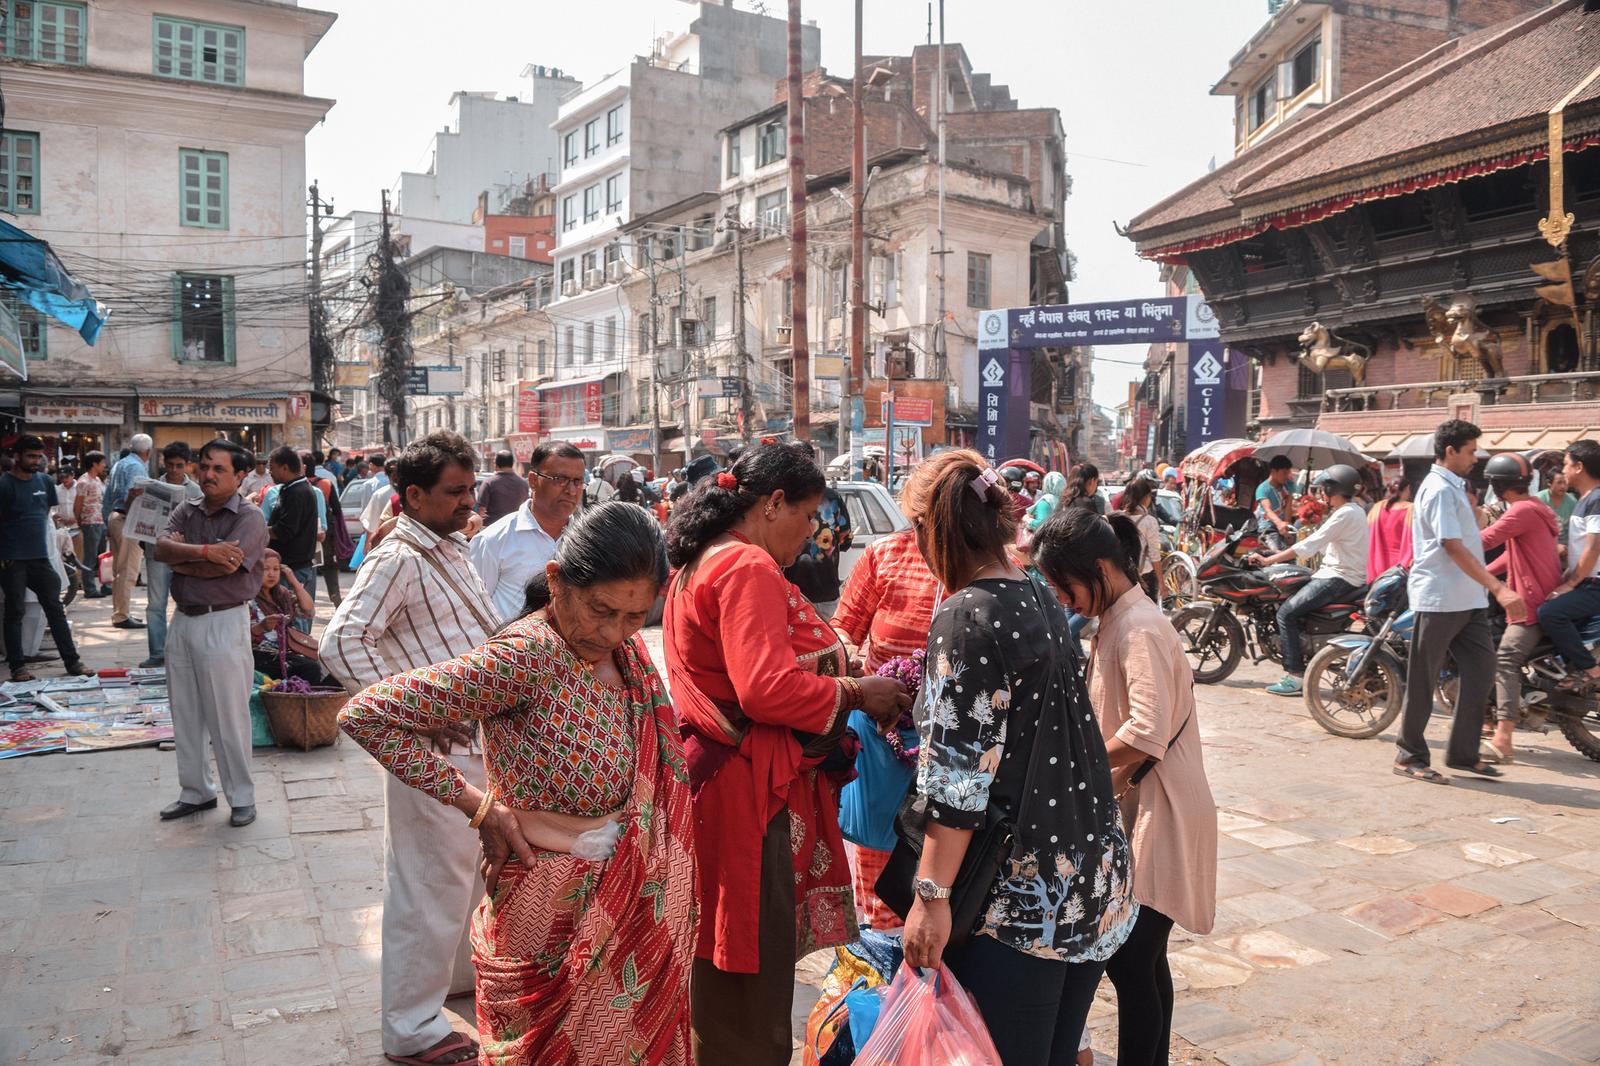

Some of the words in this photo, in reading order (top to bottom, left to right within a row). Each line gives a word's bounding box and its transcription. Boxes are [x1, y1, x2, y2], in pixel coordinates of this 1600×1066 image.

[1039, 310, 1063, 324] नेपाल
[1068, 308, 1092, 324] संवत्
[1094, 308, 1120, 321] ११३८
[1124, 307, 1137, 318] या
[143, 400, 157, 416] श्री
[220, 402, 279, 418] व्यवसायी
[1201, 388, 1213, 435] CIVIL
